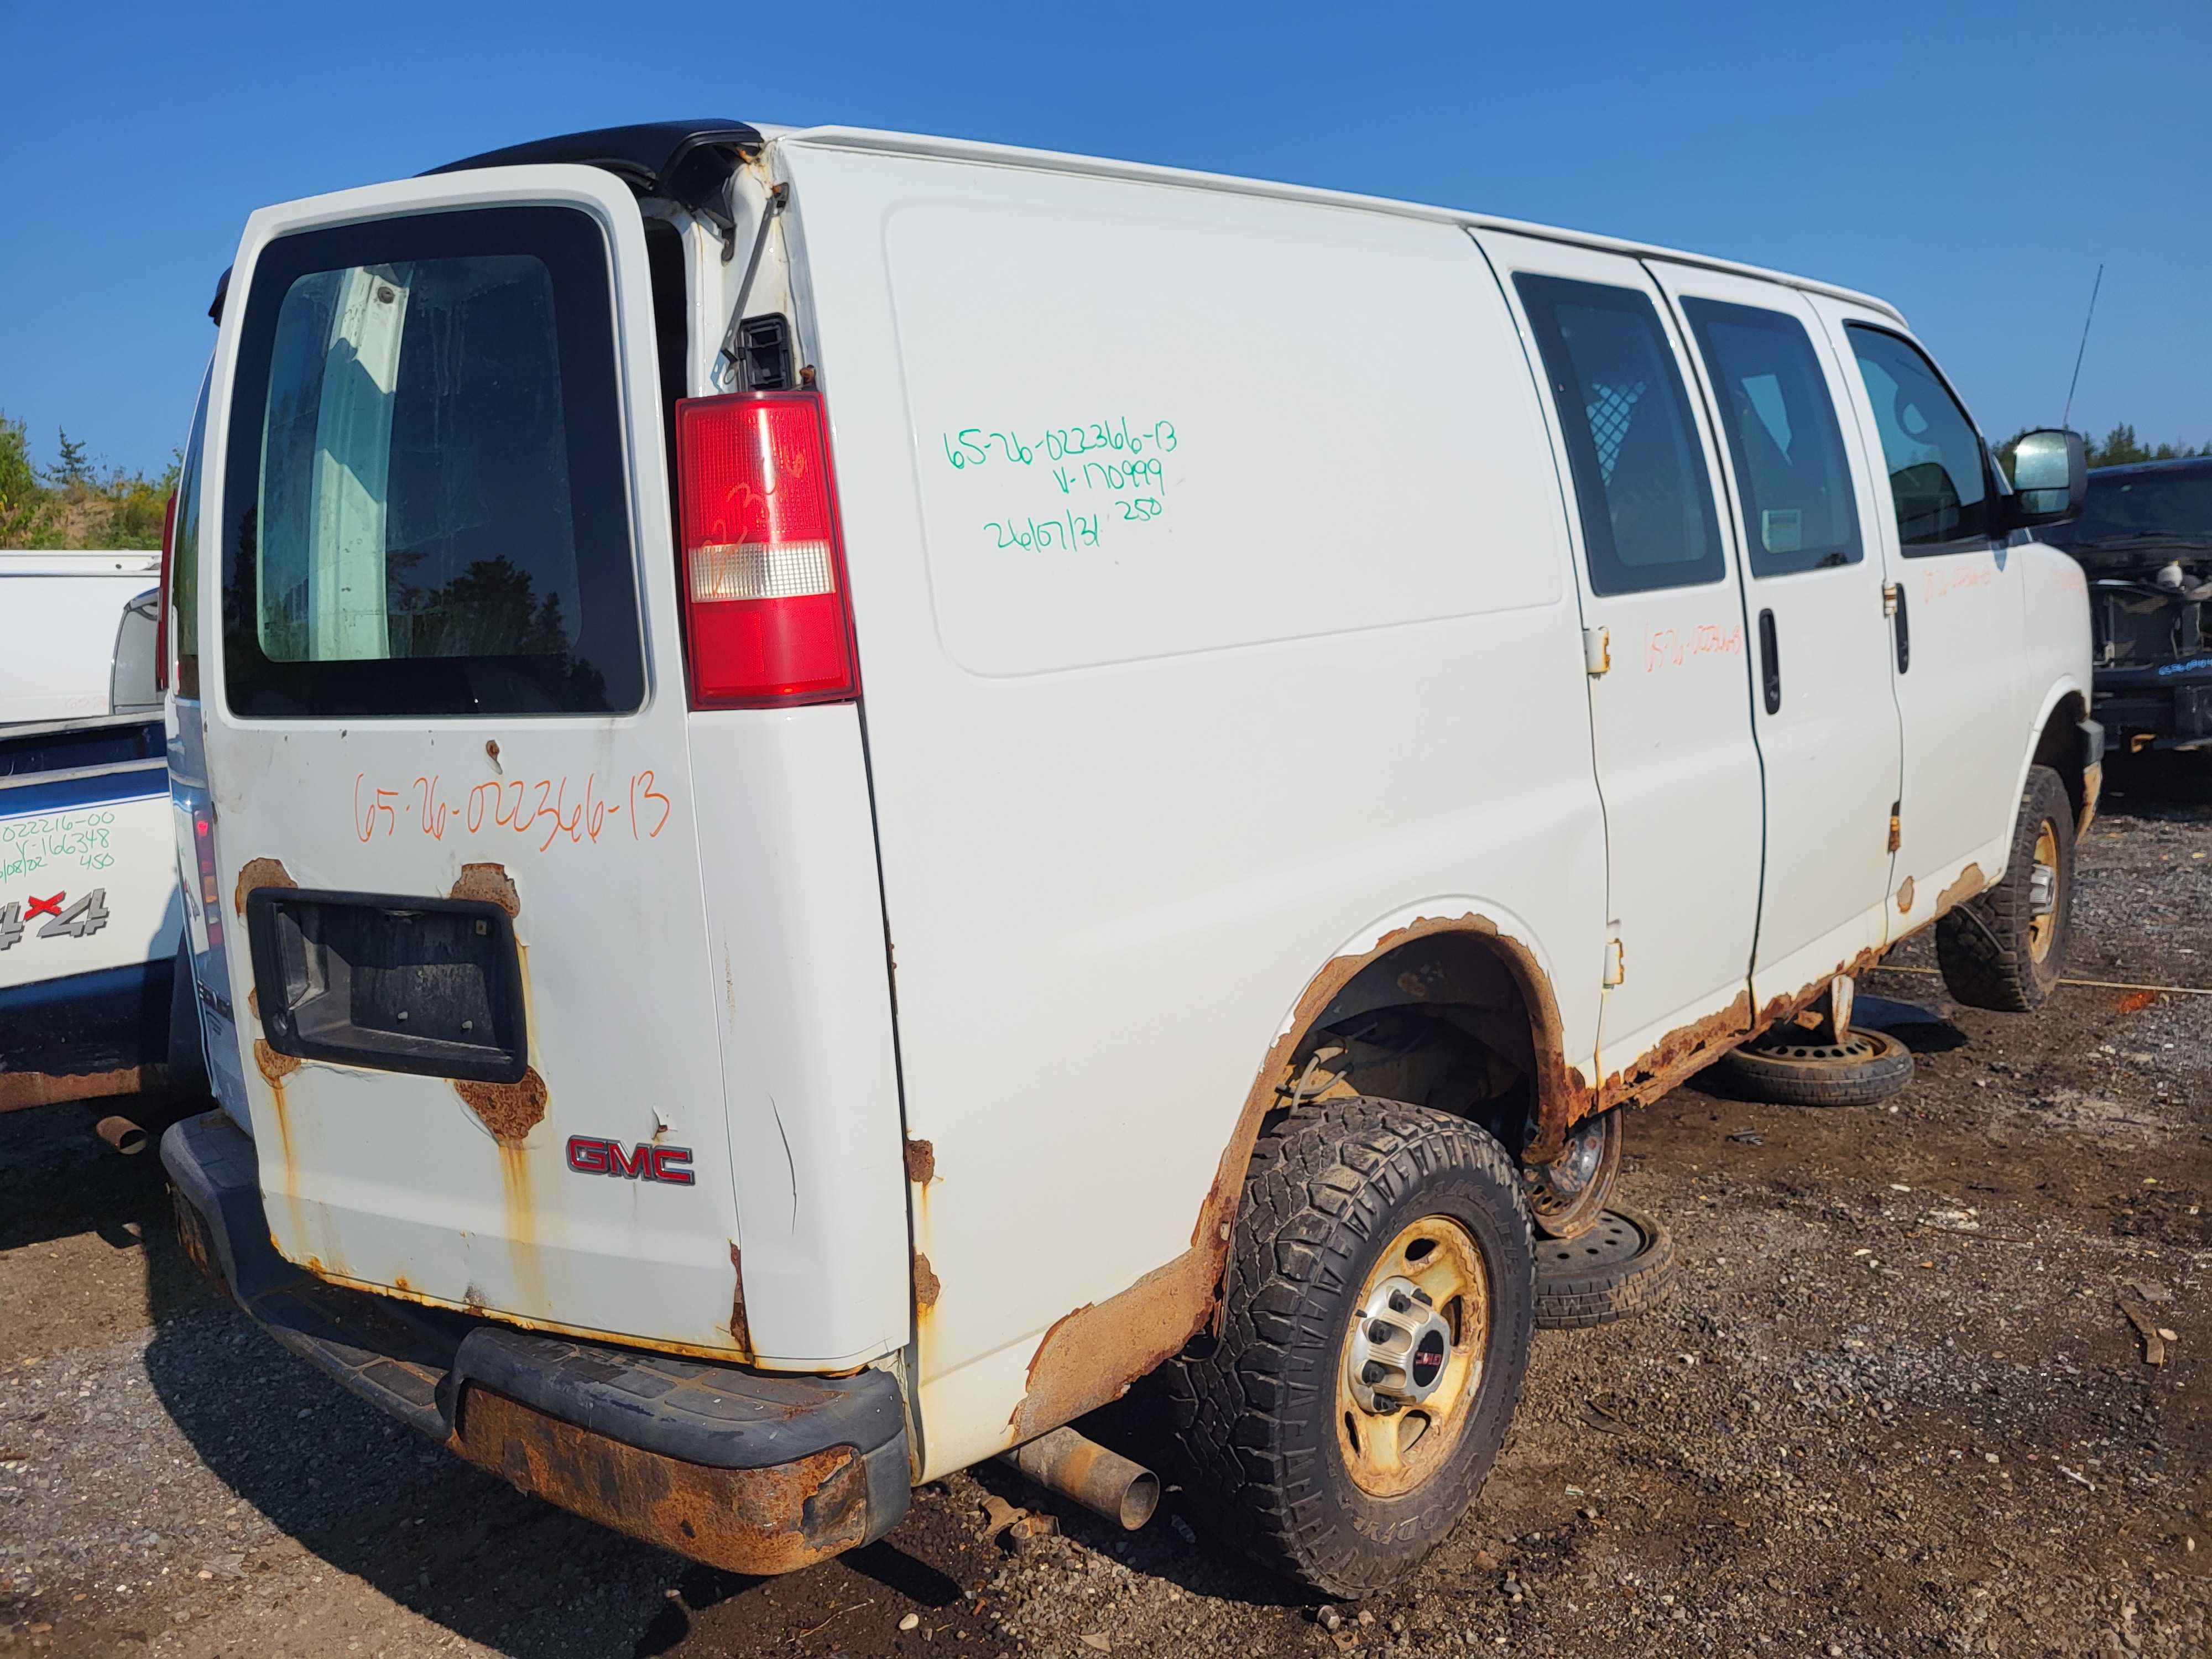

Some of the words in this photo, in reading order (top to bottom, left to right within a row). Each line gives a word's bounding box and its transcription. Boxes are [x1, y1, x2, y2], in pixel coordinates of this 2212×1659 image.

[943, 416, 1177, 469] 65-26-022366-13
[1114, 497, 1162, 521] 250
[354, 770, 670, 852] 65-26-022366-13
[80, 853, 115, 870] 450
[566, 1135, 695, 1186] GMC
